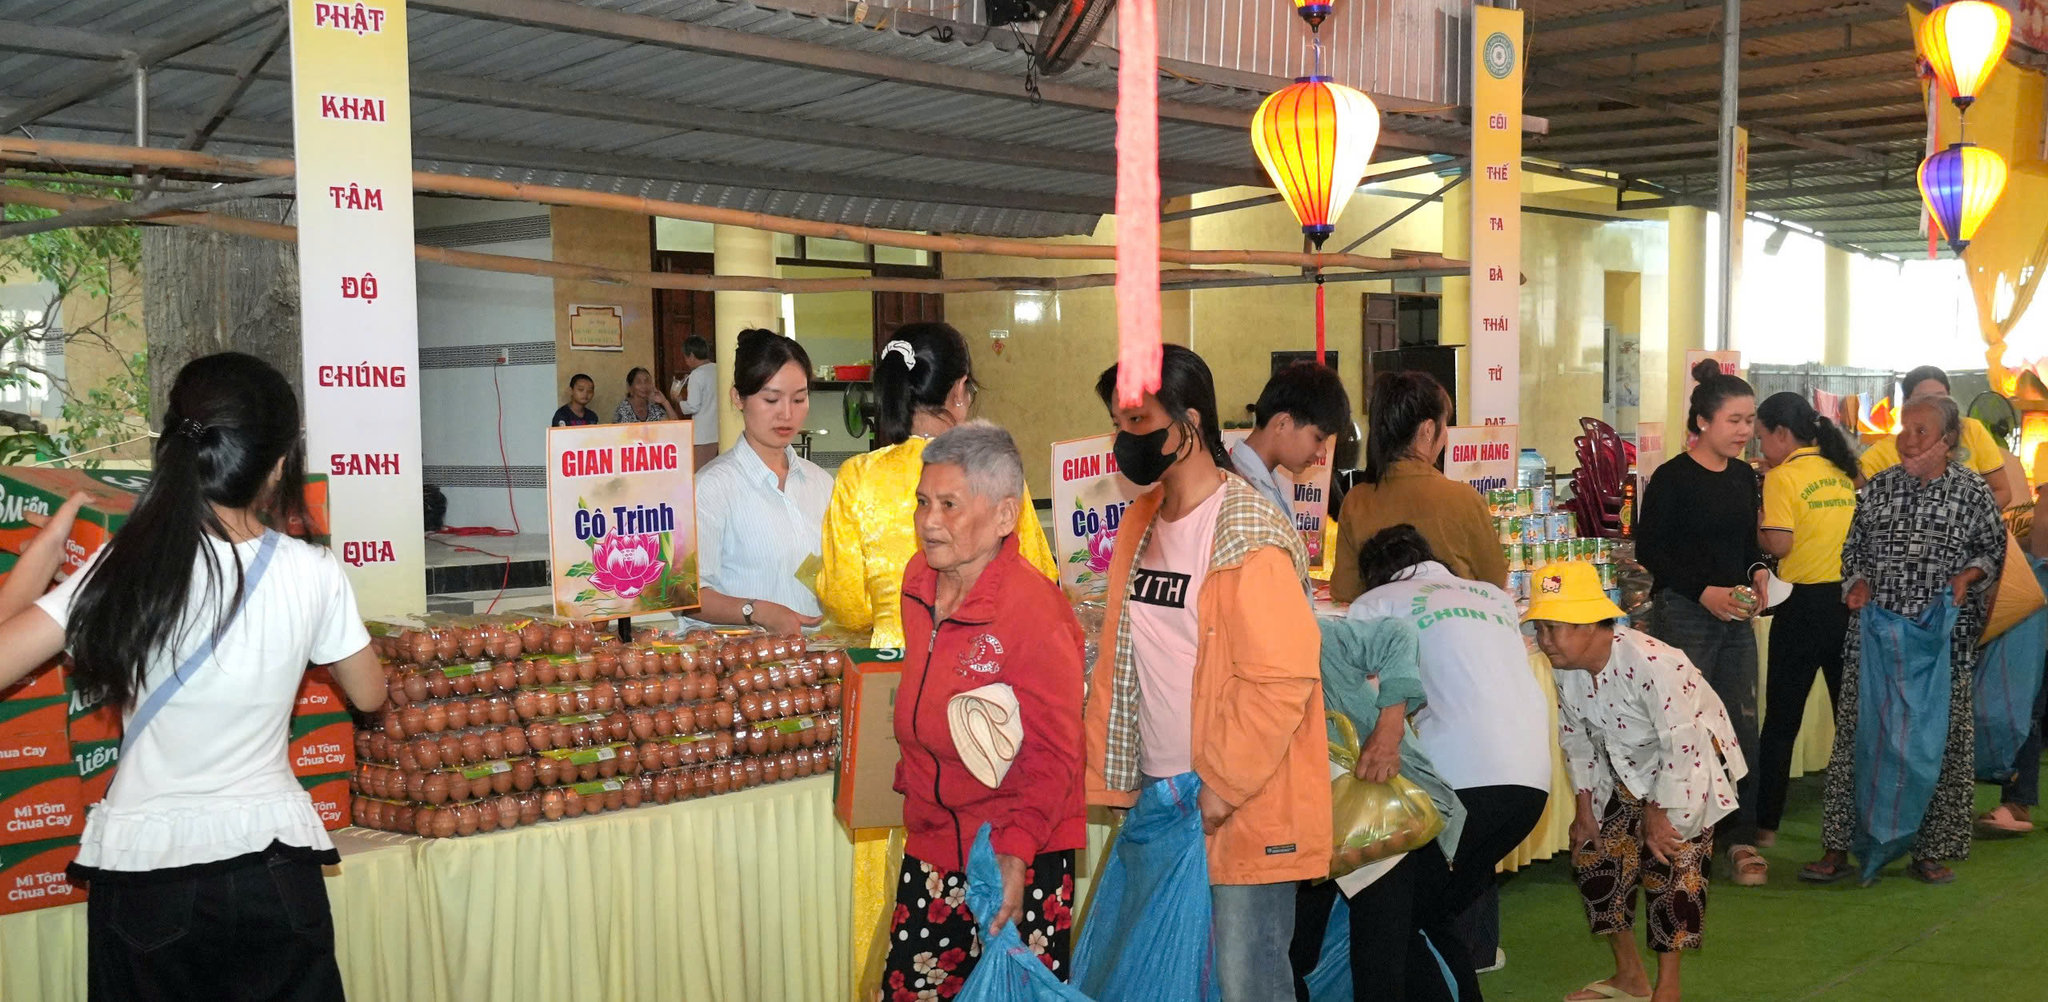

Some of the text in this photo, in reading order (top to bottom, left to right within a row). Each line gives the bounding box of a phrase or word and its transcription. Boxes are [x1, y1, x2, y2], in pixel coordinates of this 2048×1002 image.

[316, 3, 384, 35] PHẬT
[321, 95, 385, 122] KHAI
[1486, 163, 1509, 180] THẾ
[329, 182, 383, 211] TÂM
[1490, 217, 1504, 231] TA
[1489, 265, 1504, 281] BÀ
[341, 272, 378, 304] ĐỘ
[1483, 315, 1508, 332] THÁI
[318, 361, 406, 387] CHÚNG
[561, 442, 678, 477] GIAN HÀNG
[1453, 442, 1509, 462] GIAN HÀNG
[330, 453, 400, 475] SANH
[1062, 454, 1100, 482] GIAN
[574, 502, 675, 541] Cô Trinh
[1072, 500, 1134, 537] Cô Đi
[343, 540, 396, 567] QUA
[310, 695, 329, 704] Cay
[23, 746, 47, 757] Cay
[302, 744, 340, 756] Mì Tôm
[297, 753, 345, 767] Chua Cay
[14, 803, 65, 818] Mì Tôm
[321, 811, 341, 822] Cay
[6, 815, 73, 832] Chua Cay
[16, 872, 67, 887] Mì Tôm
[8, 884, 73, 901] Chua Cay
